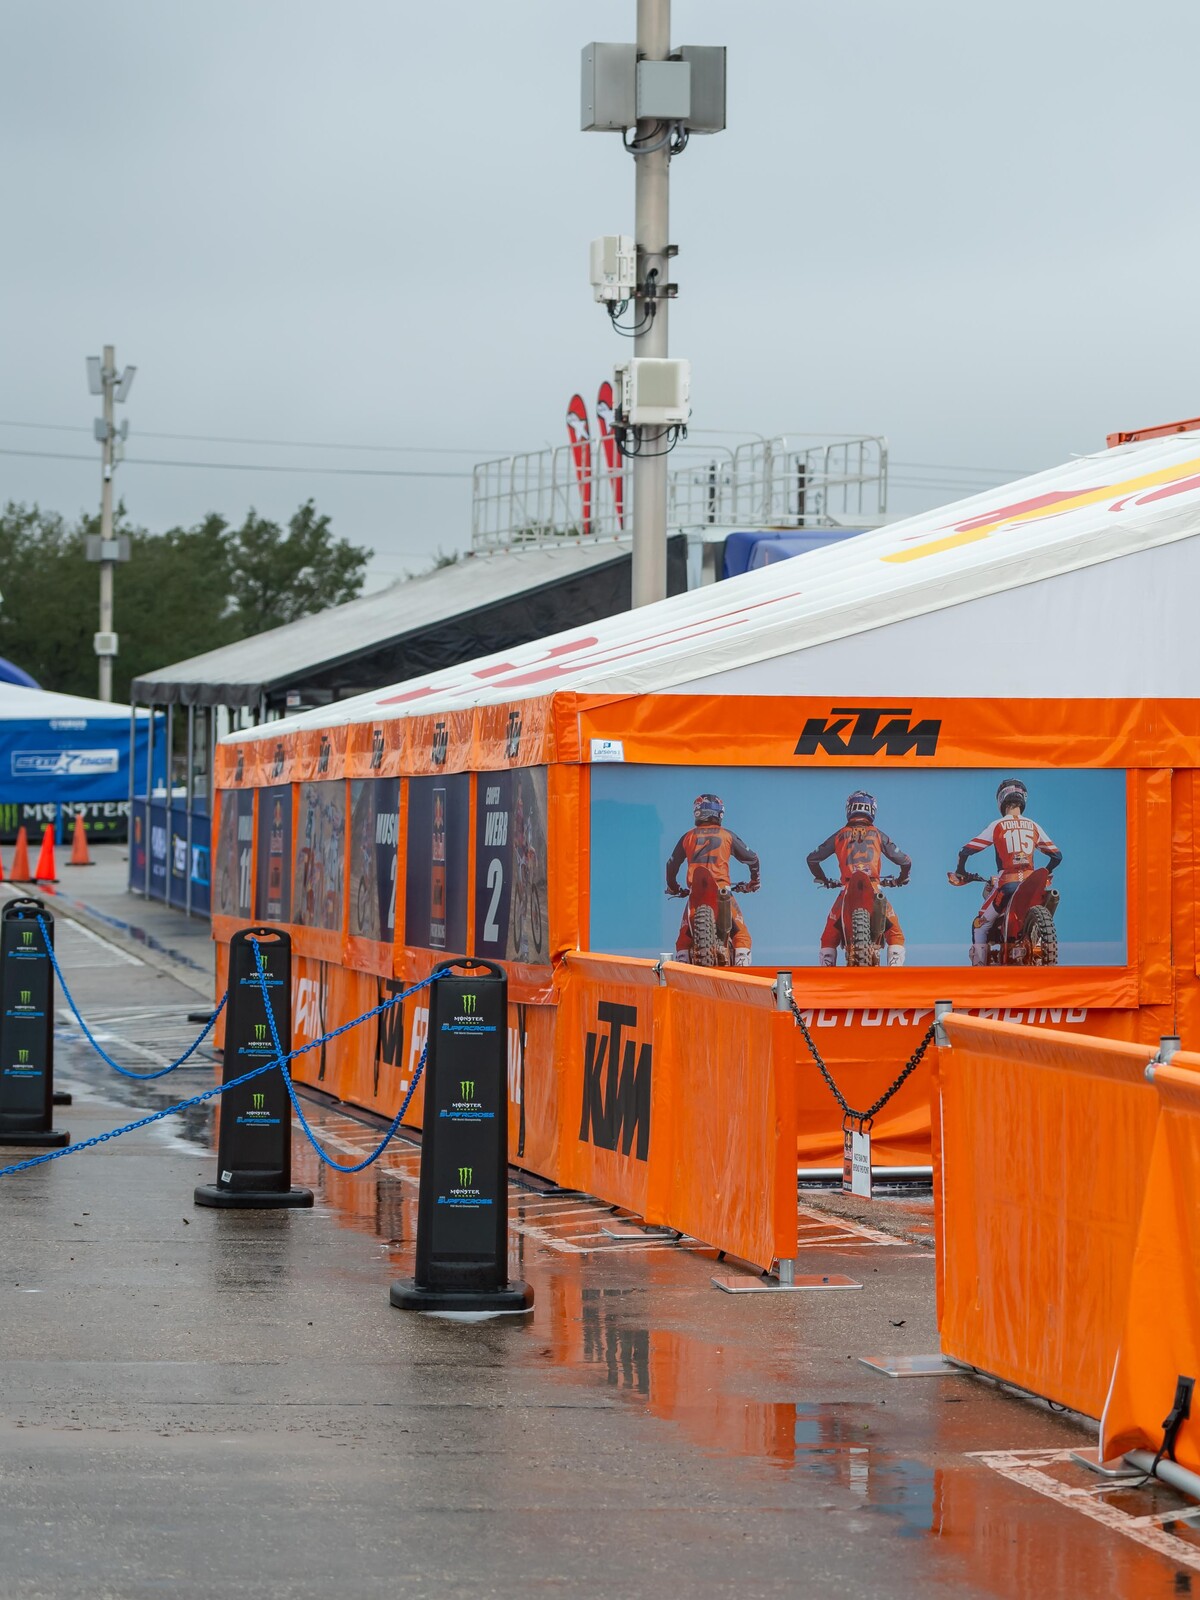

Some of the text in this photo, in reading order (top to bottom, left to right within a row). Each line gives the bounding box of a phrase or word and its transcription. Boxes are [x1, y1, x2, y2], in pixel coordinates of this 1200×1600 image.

[431, 722, 449, 765] KTM
[793, 707, 942, 757] KTM
[484, 811, 509, 846] WEBB
[1000, 820, 1034, 831] VOHLAND
[1003, 829, 1034, 855] 115
[690, 835, 722, 864] 2
[483, 858, 503, 943] 2
[578, 1000, 653, 1163] KTM
